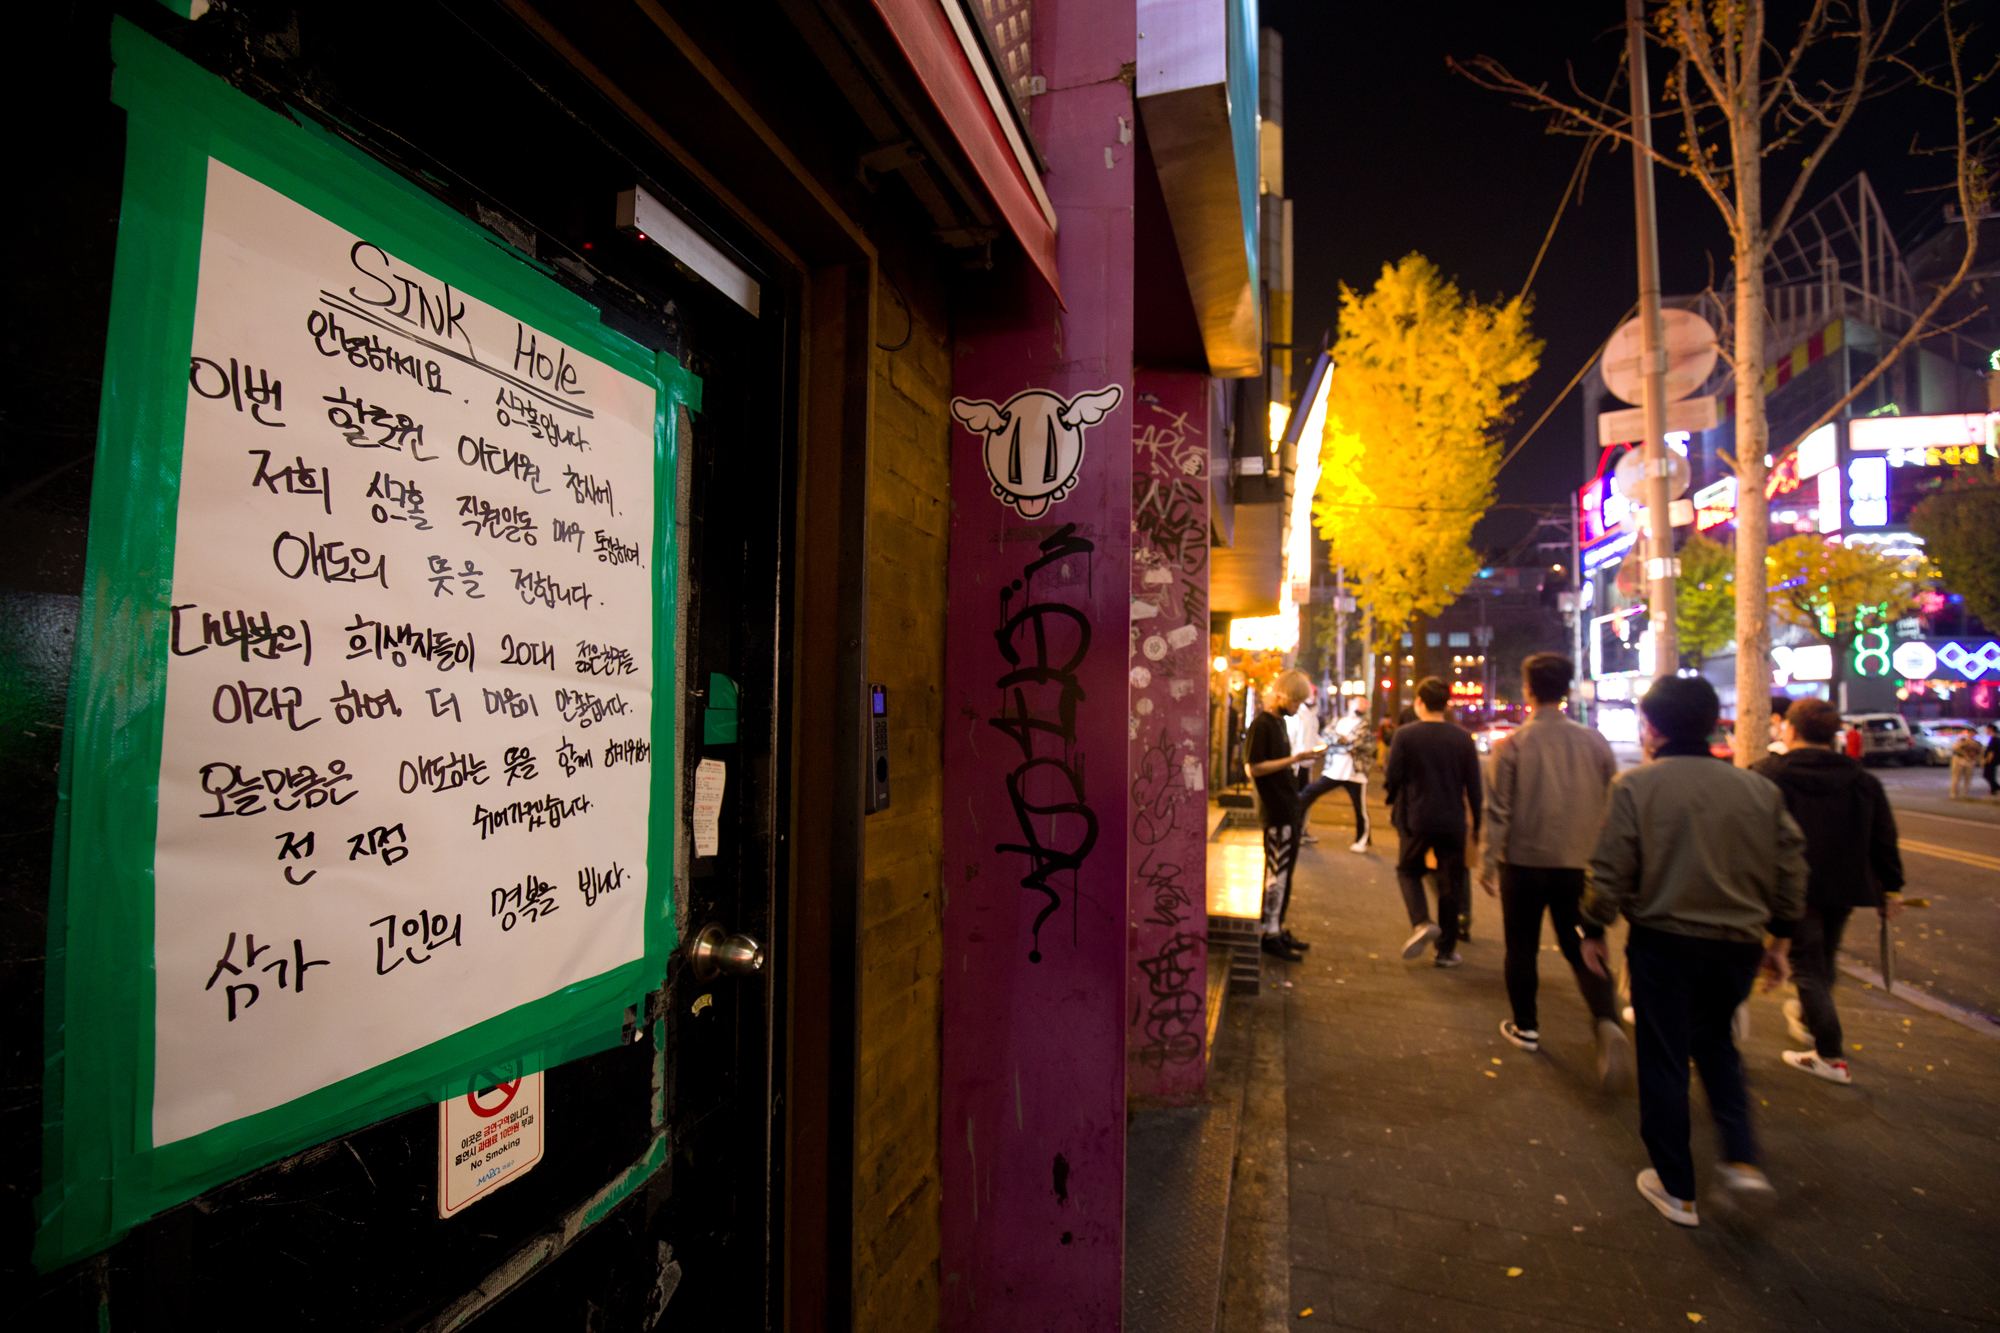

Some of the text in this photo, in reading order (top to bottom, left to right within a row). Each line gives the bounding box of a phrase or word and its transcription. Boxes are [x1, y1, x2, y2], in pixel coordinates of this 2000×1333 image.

[513, 322, 586, 395] Hole
[189, 357, 287, 427] 이번
[457, 434, 552, 495] 이태원
[248, 449, 334, 515] 저희
[365, 471, 434, 531] 싱크홀
[455, 495, 539, 547] 직원일동
[552, 518, 586, 553] 매우
[272, 530, 604, 610] 애도의 뜻을 전합니다.
[170, 604, 312, 667] 대부분의
[345, 613, 476, 673] 희생자들이
[500, 634, 556, 669] 20대
[425, 687, 462, 722] 더
[484, 687, 539, 719] 마음이
[199, 759, 359, 818] 오늘만큼은
[398, 751, 490, 794] 애도하는
[504, 746, 539, 786] 뜻을
[556, 735, 593, 778] 함께
[275, 831, 318, 886] 전
[347, 823, 409, 866] 지점
[205, 932, 331, 1022] 삼가
[370, 910, 462, 976] 고인의
[491, 874, 560, 932] 명복을
[461, 1130, 483, 1149] 이곳은
[471, 1137, 521, 1171] No Smoking
